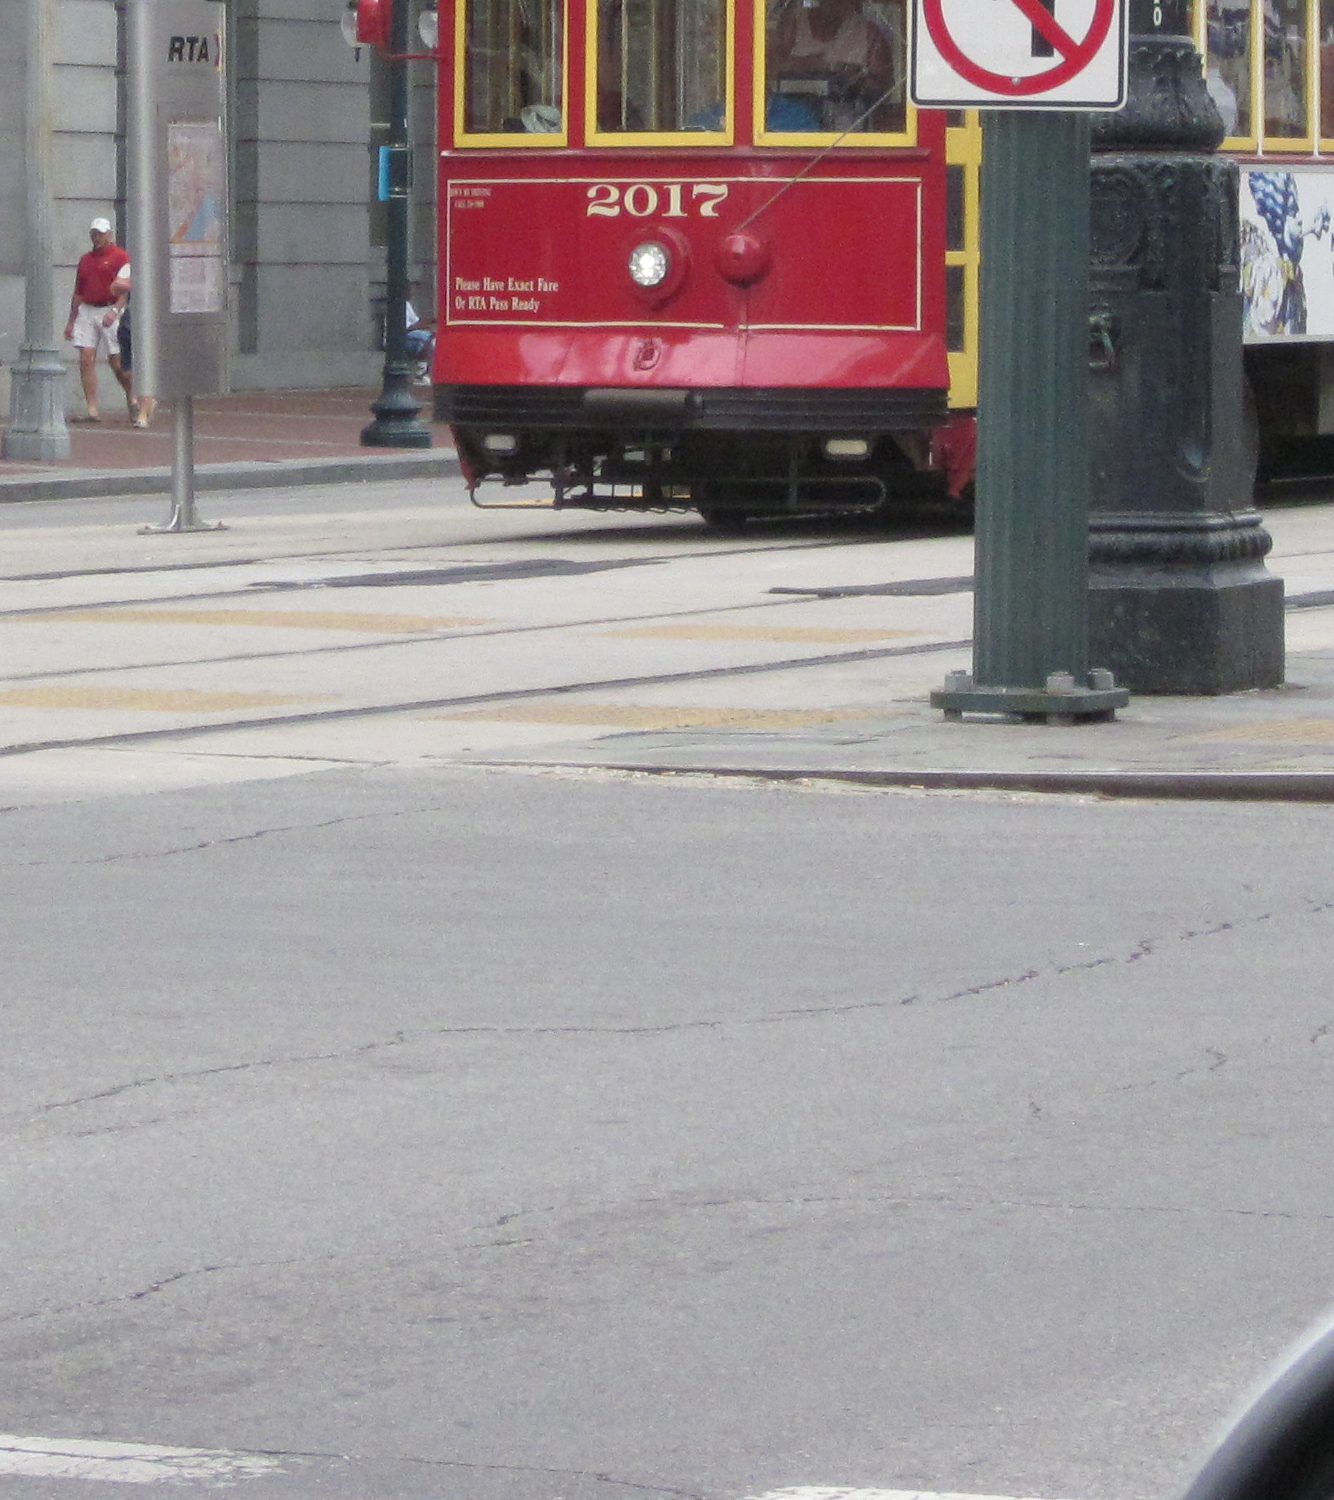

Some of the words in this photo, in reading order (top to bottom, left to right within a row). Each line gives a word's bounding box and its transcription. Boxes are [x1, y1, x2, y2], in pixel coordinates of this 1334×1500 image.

[167, 36, 209, 62] RTA
[586, 183, 728, 217] 2017
[455, 277, 480, 291] Please
[483, 277, 504, 292] Have
[508, 277, 535, 292] Exact
[537, 277, 559, 292] Fare
[455, 296, 466, 310] Or
[468, 296, 486, 310] RTA
[489, 297, 508, 311] Pass
[512, 297, 540, 313] Ready
